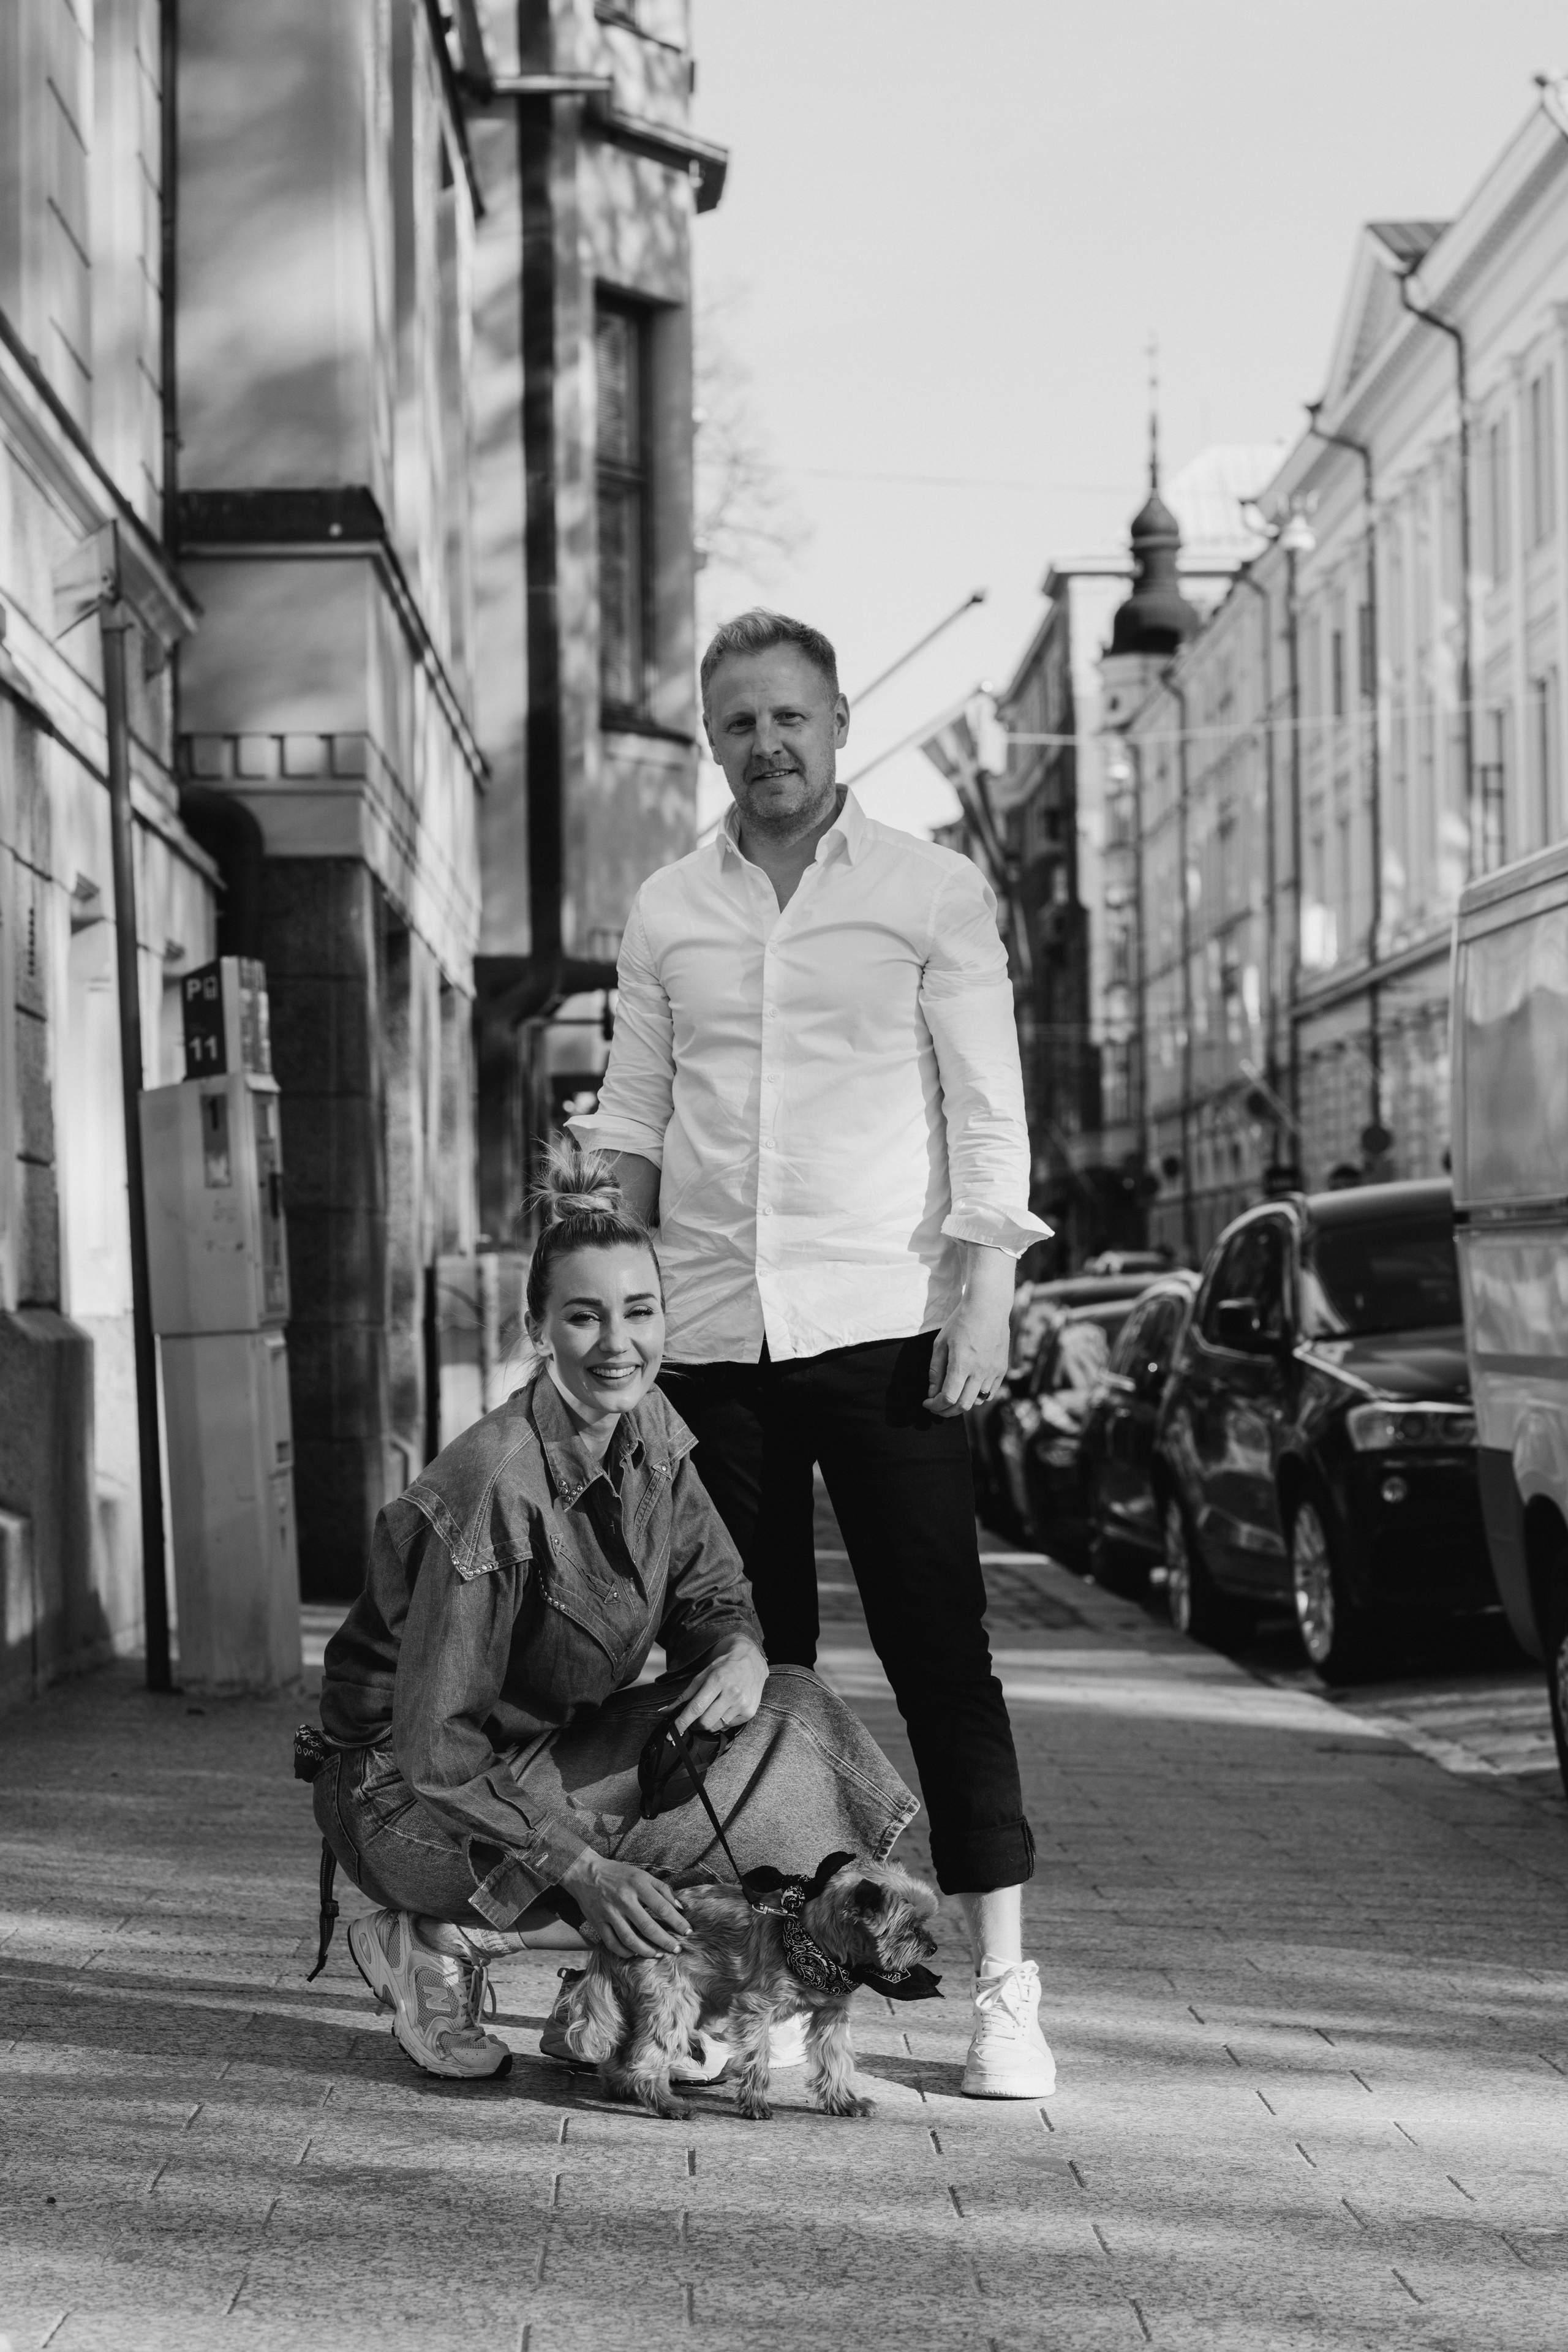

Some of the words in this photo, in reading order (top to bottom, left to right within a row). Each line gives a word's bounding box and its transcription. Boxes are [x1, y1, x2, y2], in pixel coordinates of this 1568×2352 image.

[187, 978, 202, 1001] P
[189, 1036, 217, 1061] 11
[423, 1986, 451, 2011] N
